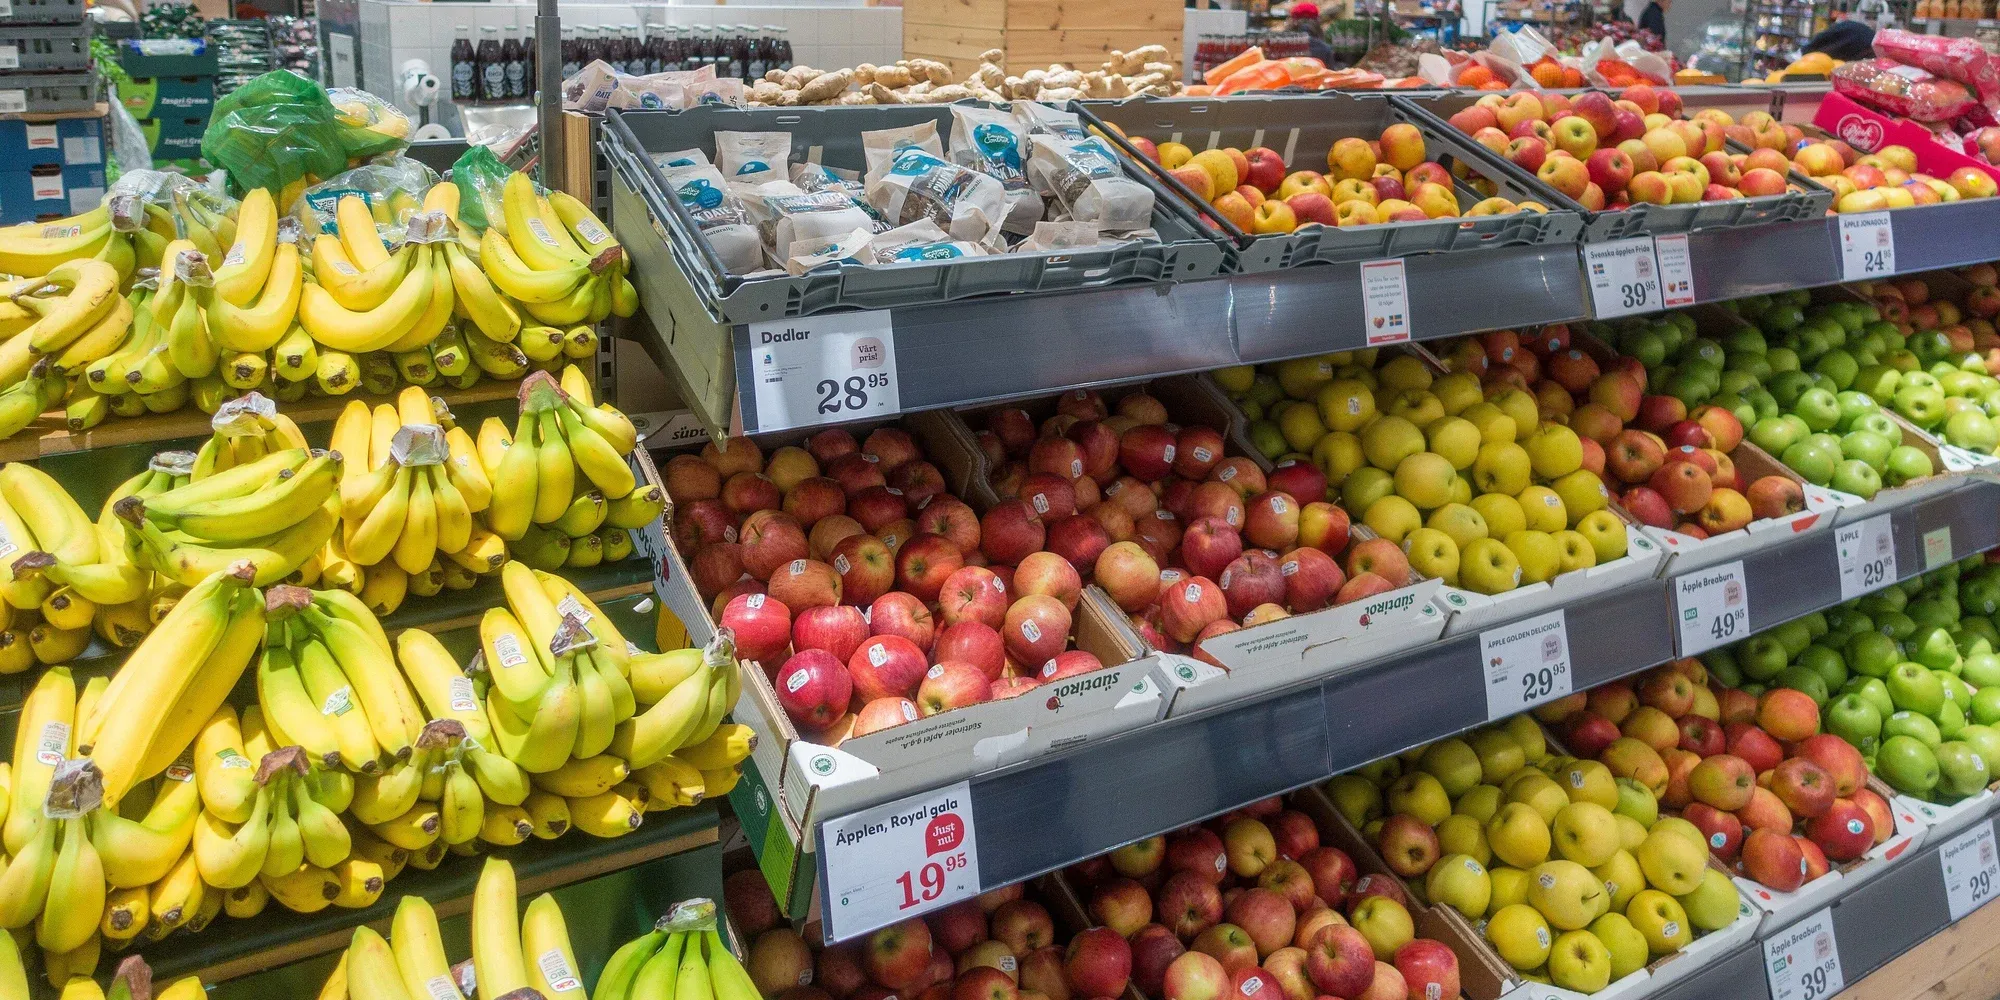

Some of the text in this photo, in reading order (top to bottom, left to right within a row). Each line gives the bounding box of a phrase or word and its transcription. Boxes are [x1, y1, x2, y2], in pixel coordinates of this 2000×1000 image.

[705, 227, 734, 237] naturally
[1590, 245, 1650, 259] Svenska äpplen Frida
[1865, 251, 1884, 272] 24
[1621, 281, 1656, 308] 39 95
[761, 328, 810, 344] Dadlar
[858, 344, 877, 353] Vårt
[859, 353, 878, 363] pris!
[816, 372, 889, 415] 28 95
[1840, 530, 1859, 544] ÄPPLE
[1863, 560, 1885, 587] 29
[1883, 555, 1893, 567] 95
[1682, 573, 1734, 594] Äpple Breaburn
[1685, 609, 1697, 619] EKO
[1711, 608, 1745, 640] 49 95
[1487, 621, 1561, 650] ÄPPLE GOLDEN DELICIOUS
[502, 647, 517, 656] BIO
[1546, 640, 1557, 649] Vårt
[1522, 667, 1553, 702] 29
[1553, 662, 1566, 676] 95
[885, 734, 908, 745] Angabe
[901, 722, 982, 750] Südtiroler Apfel g.g.A.
[44, 742, 61, 750] BIO
[835, 798, 958, 847] Äpplen, Royal gala
[932, 821, 956, 837] Just
[937, 833, 955, 847] nu!
[1977, 828, 1991, 843] Smith
[895, 852, 967, 911] 19 95
[1970, 864, 1997, 902] 29 95
[1771, 922, 1822, 957] Äpple Breaburn
[550, 969, 567, 980] BIO
[1801, 958, 1836, 1000] 39 95
[556, 980, 576, 990] Dole
